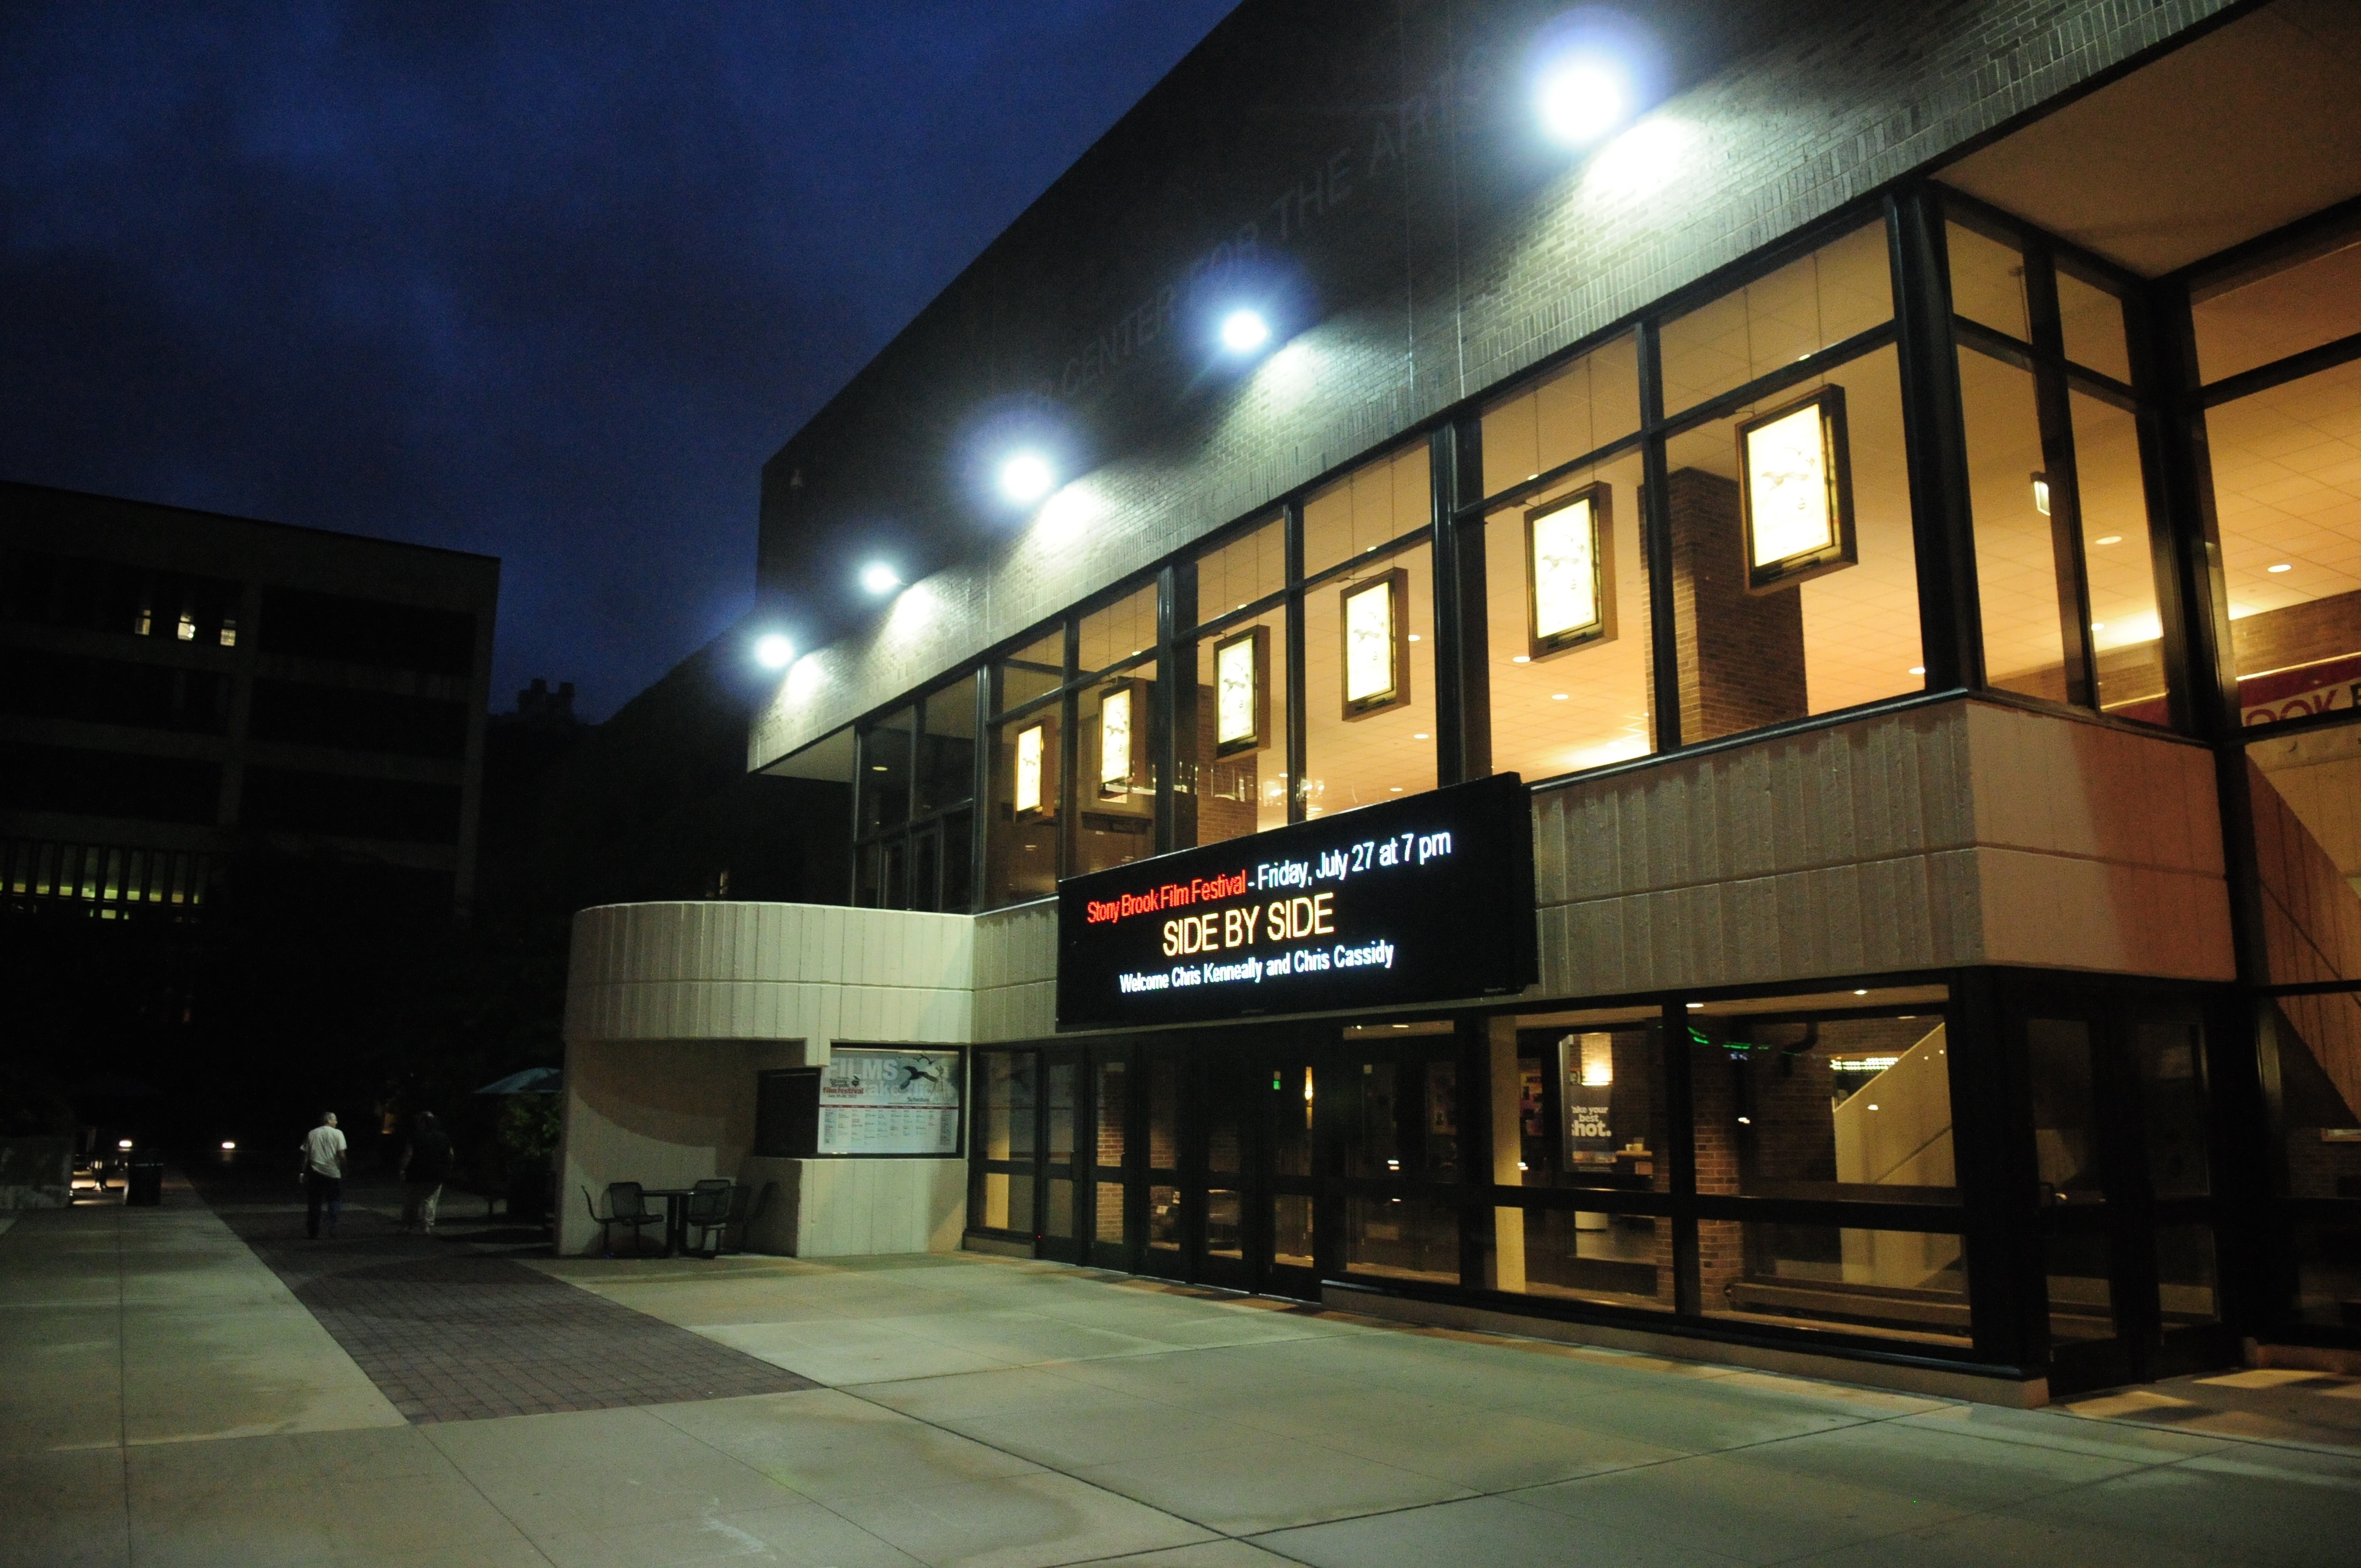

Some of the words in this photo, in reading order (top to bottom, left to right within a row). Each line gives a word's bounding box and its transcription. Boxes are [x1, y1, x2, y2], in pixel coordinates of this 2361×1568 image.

[1270, 145, 1352, 240] THE
[1086, 900, 1120, 923] Stony
[1121, 888, 1160, 917] Brook
[1160, 884, 1189, 909] Film
[1190, 868, 1247, 902] Festival
[1258, 860, 1313, 890] Friday,
[1315, 849, 1349, 881] July
[1351, 841, 1375, 872] 27
[1379, 837, 1399, 867] at
[1401, 832, 1415, 862] 7
[1418, 831, 1451, 865] pm
[1162, 912, 1220, 957] SIDE
[1225, 905, 1261, 948] BY
[1267, 892, 1335, 941] SIDE
[1119, 972, 1169, 993] Welcome
[1171, 965, 1201, 988] Chris
[1203, 956, 1263, 984] Kenneally
[1266, 952, 1291, 977] and
[1293, 948, 1330, 973] Chris
[1333, 939, 1395, 969] Cassidy
[825, 1057, 898, 1080] FILMS
[1579, 1114, 1600, 1123] best
[1588, 1107, 1609, 1115] your
